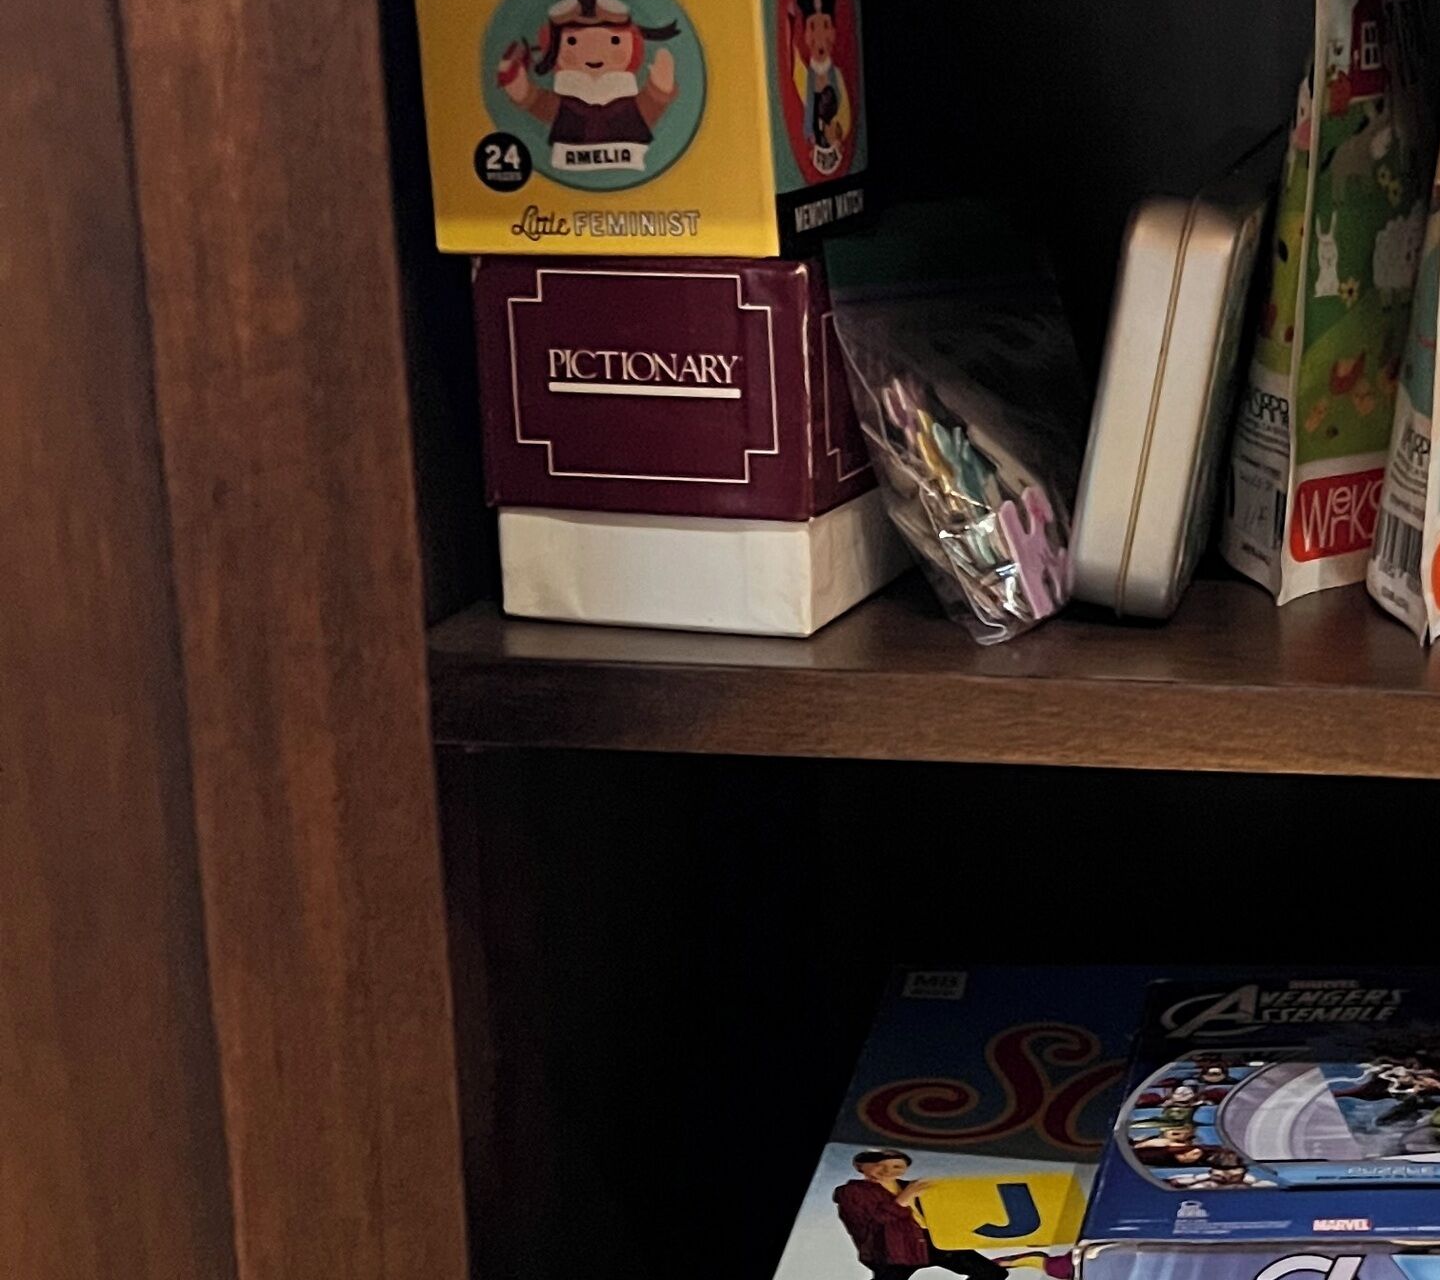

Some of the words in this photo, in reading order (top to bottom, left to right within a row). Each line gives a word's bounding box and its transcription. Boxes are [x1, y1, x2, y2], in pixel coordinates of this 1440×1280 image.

[484, 144, 521, 170] 24
[565, 148, 633, 166] AMELIA
[511, 204, 571, 242] Little
[572, 209, 701, 238] FEMINIST
[548, 348, 740, 384] PICTIONARY
[1312, 1219, 1370, 1232] MARVEL
